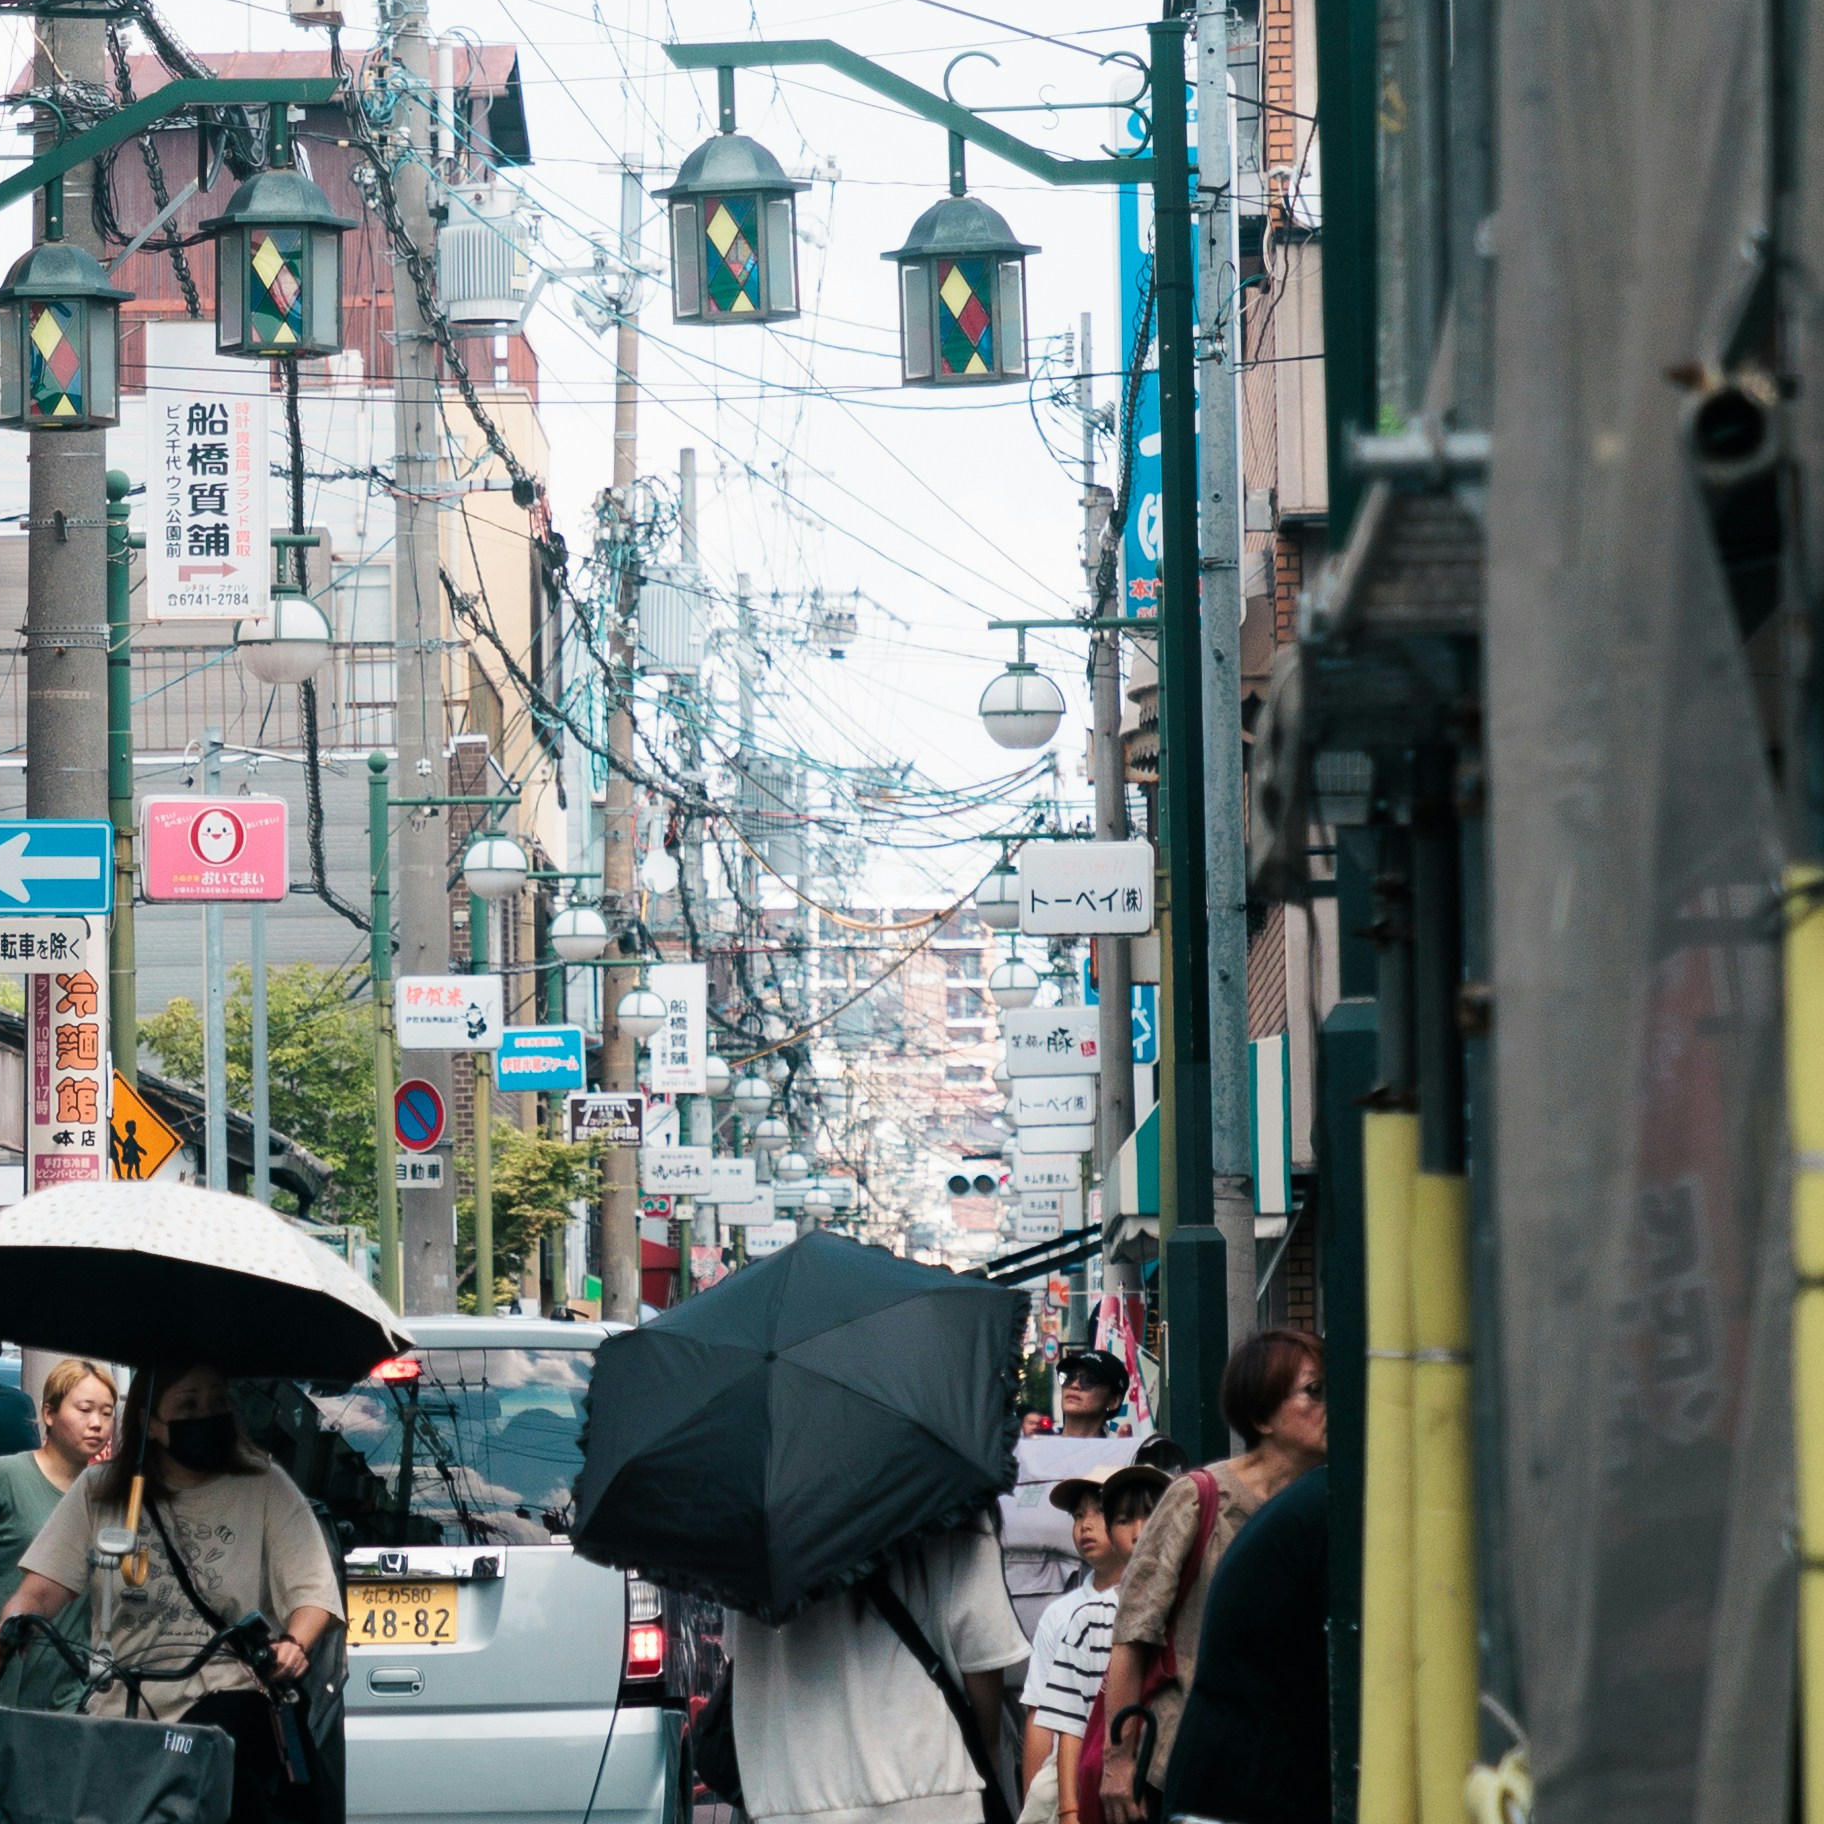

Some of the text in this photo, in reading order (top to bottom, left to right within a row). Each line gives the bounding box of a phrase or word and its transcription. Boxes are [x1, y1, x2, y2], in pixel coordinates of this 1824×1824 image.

[187, 402, 229, 557] 船橋質舗
[236, 530, 250, 556] 買取
[179, 593, 249, 606] 6741-2784
[201, 871, 265, 886] おいでまい
[1031, 886, 1143, 913] トーベイ(株)
[670, 999, 688, 1066] 船橋質舗
[56, 1129, 96, 1147] 本店
[395, 1162, 441, 1181] 自動車
[362, 1608, 450, 1638] 48-82
